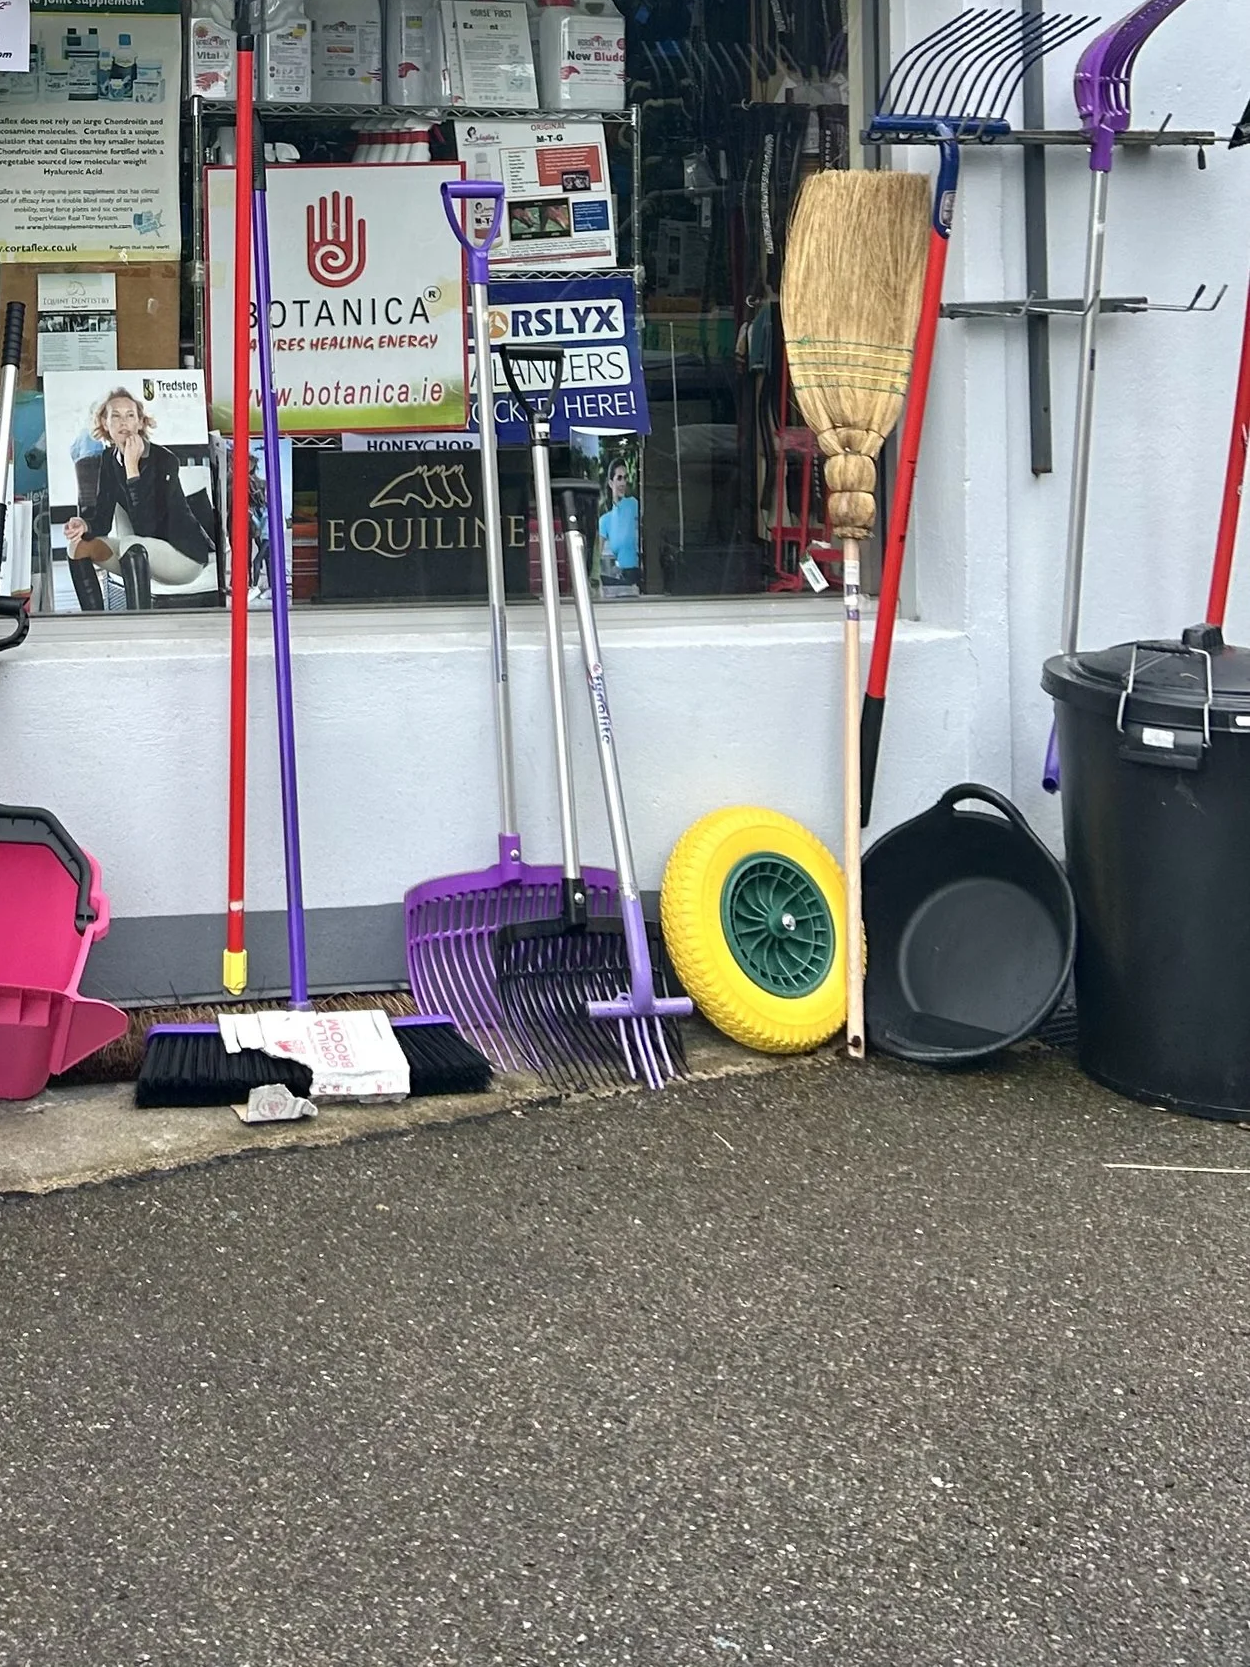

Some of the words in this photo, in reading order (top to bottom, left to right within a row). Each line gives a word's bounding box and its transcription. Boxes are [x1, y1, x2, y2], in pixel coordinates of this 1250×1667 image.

[567, 51, 591, 61] New
[55, 118, 69, 126] rely
[84, 118, 102, 126] large
[531, 123, 566, 131] ORIGINAL
[0, 158, 34, 166] vegetable
[123, 159, 147, 167] weight
[44, 168, 84, 176] Hyaluronic
[250, 297, 430, 328] BOTANICA
[250, 338, 305, 352] ARES
[310, 336, 374, 351] HEALING
[378, 334, 438, 349] ENERGY
[470, 352, 624, 387] LANCERS
[157, 381, 198, 391] Tredstep
[469, 397, 555, 423] OCKED
[564, 391, 636, 418] HERE!
[328, 516, 525, 558] EQUILINE
[314, 1020, 338, 1068] GORILLA
[326, 1019, 354, 1068] BROOM
